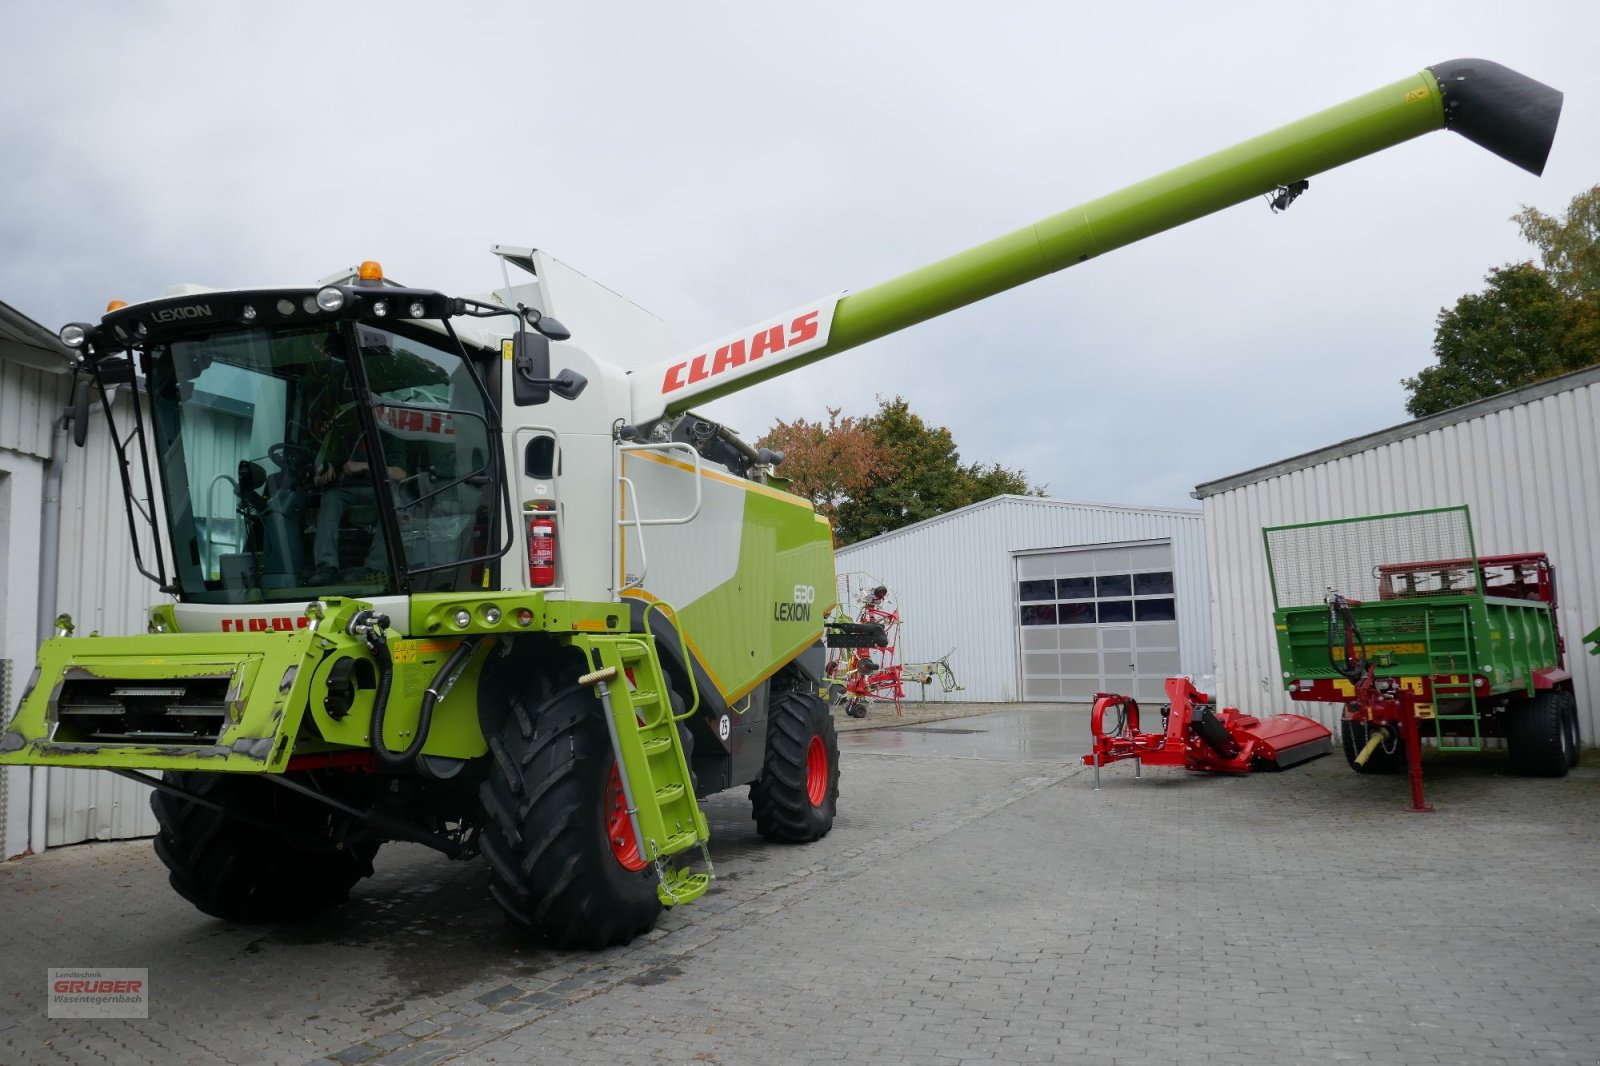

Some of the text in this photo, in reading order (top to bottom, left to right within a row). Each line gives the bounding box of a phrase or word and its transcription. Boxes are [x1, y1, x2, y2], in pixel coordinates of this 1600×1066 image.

[151, 304, 212, 323] LEXION
[661, 310, 819, 394] CLAAS
[774, 602, 811, 622] LEXION
